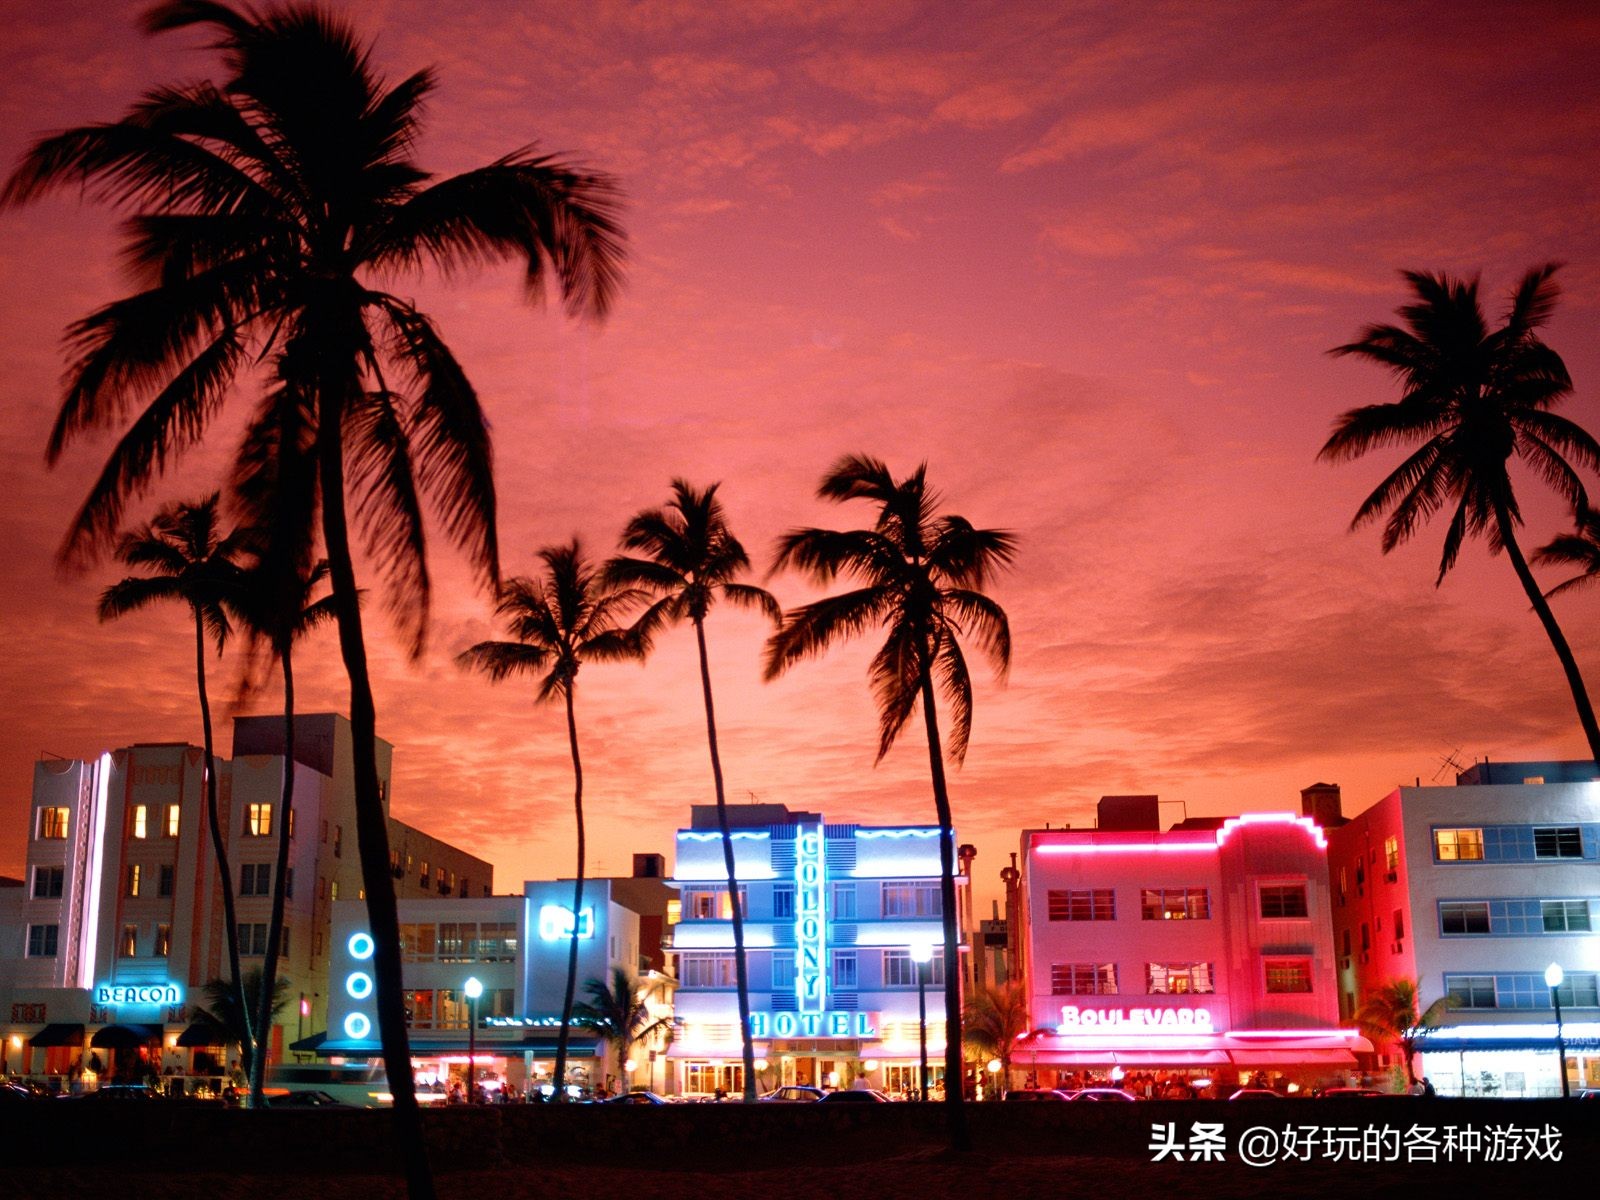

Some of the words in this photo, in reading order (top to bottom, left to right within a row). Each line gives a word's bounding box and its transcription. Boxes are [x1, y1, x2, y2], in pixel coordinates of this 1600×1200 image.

[802, 834, 819, 997] COLONY
[98, 987, 178, 1003] BEACON
[750, 1013, 875, 1036] HOTEL
[1060, 1005, 1212, 1027] BOULEVARD
